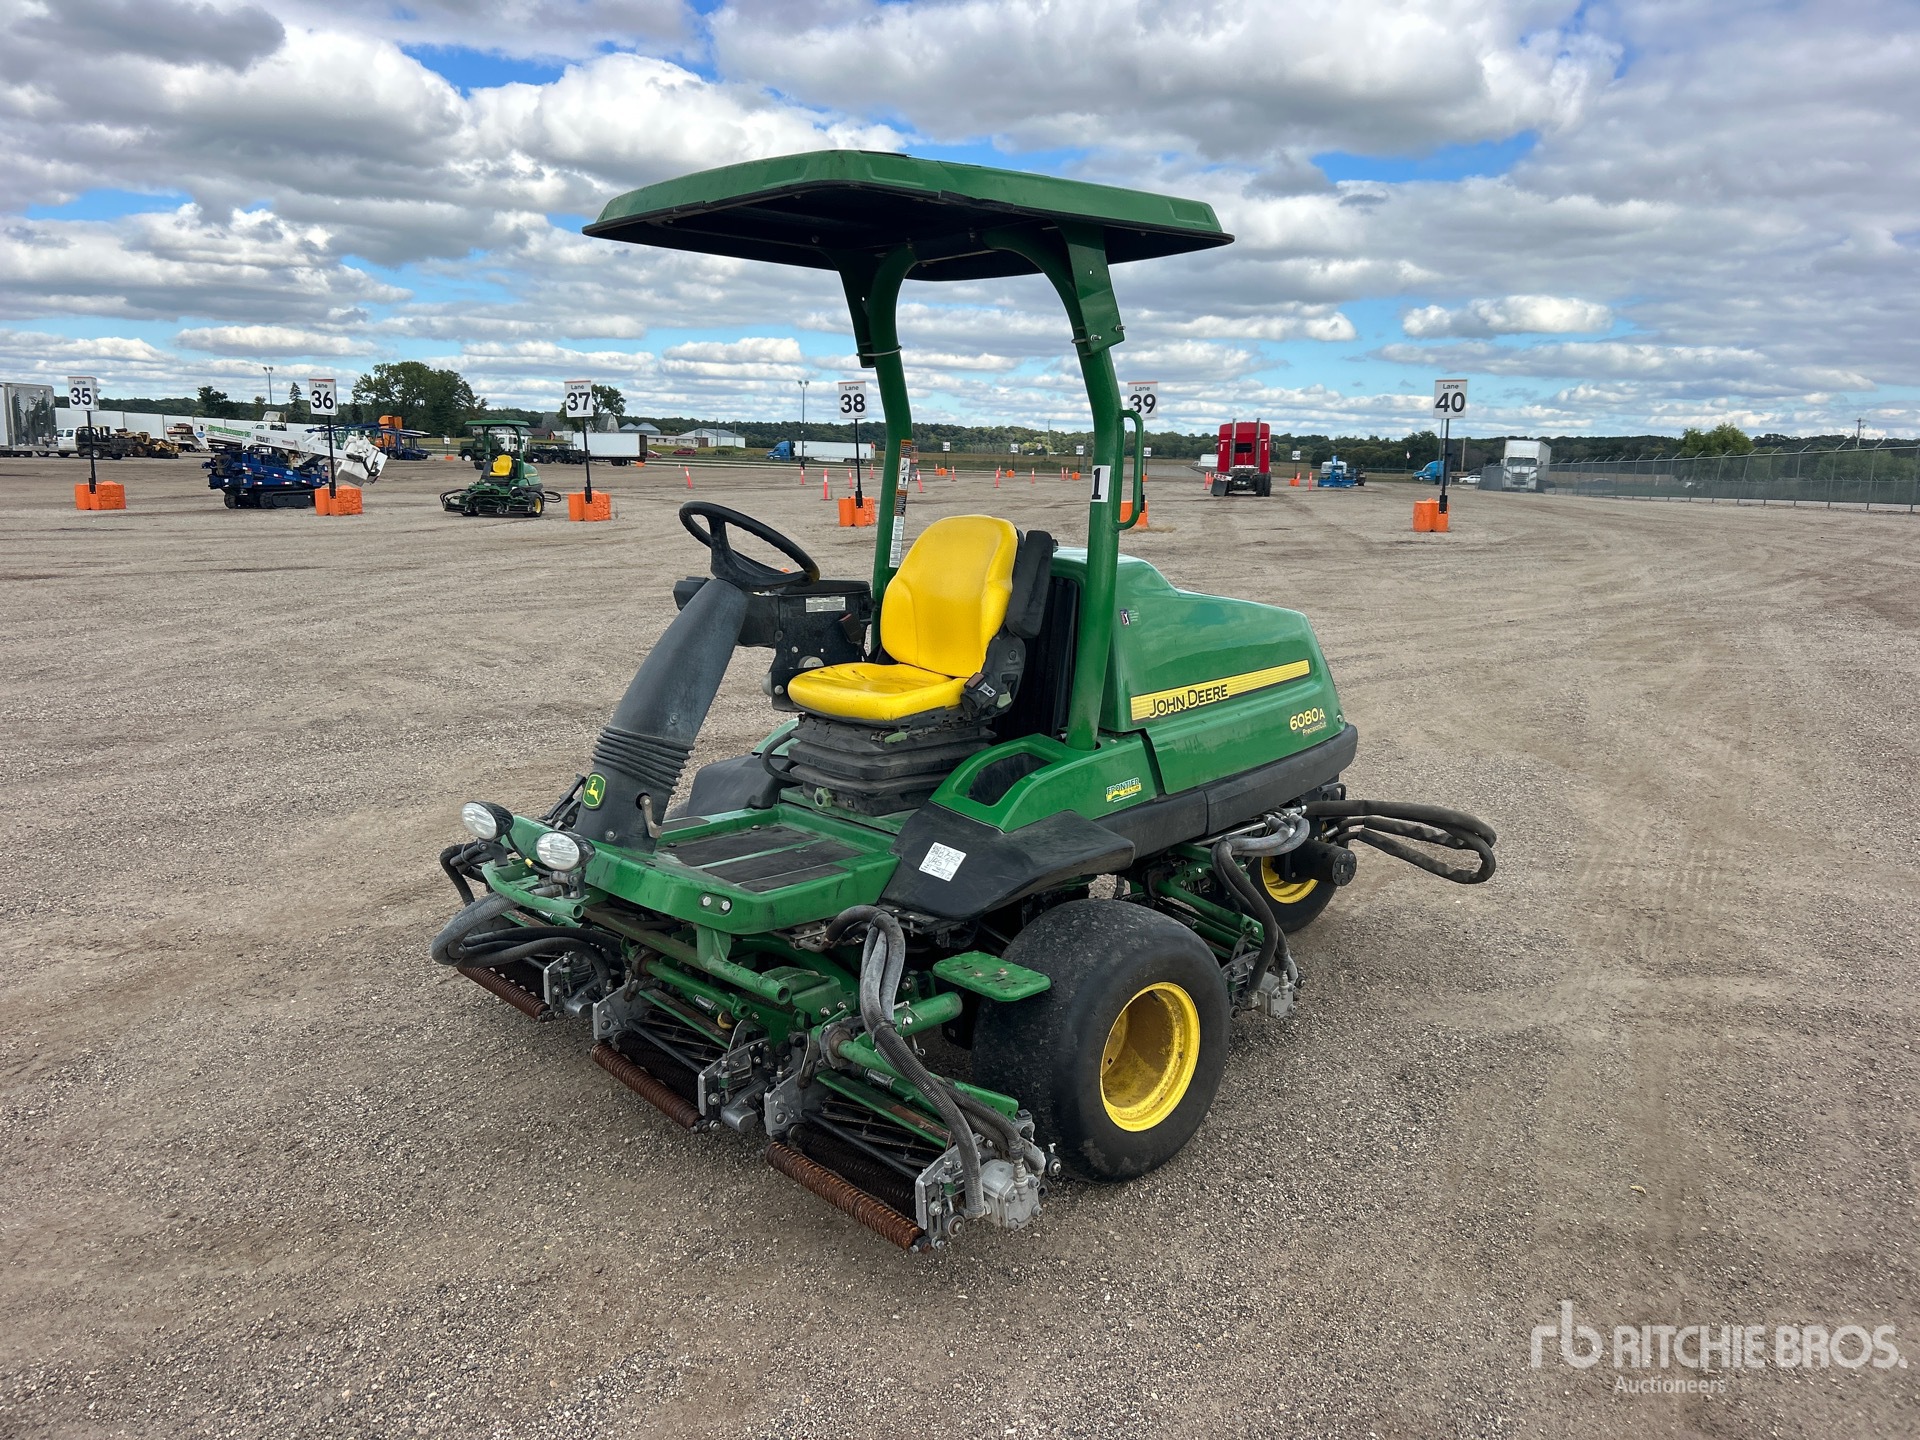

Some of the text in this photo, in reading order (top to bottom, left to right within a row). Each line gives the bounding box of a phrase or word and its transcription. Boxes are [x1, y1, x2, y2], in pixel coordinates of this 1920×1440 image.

[70, 387, 92, 406] 35
[311, 390, 334, 410] 36
[567, 391, 591, 412] 37
[840, 393, 866, 414] 38
[1130, 393, 1156, 414] 39
[1434, 391, 1466, 413] 40
[1091, 467, 1102, 500] 1
[1149, 683, 1229, 717] JOHN DEERE
[1289, 707, 1326, 731] 6080A
[1107, 778, 1139, 794] FRONTIER
